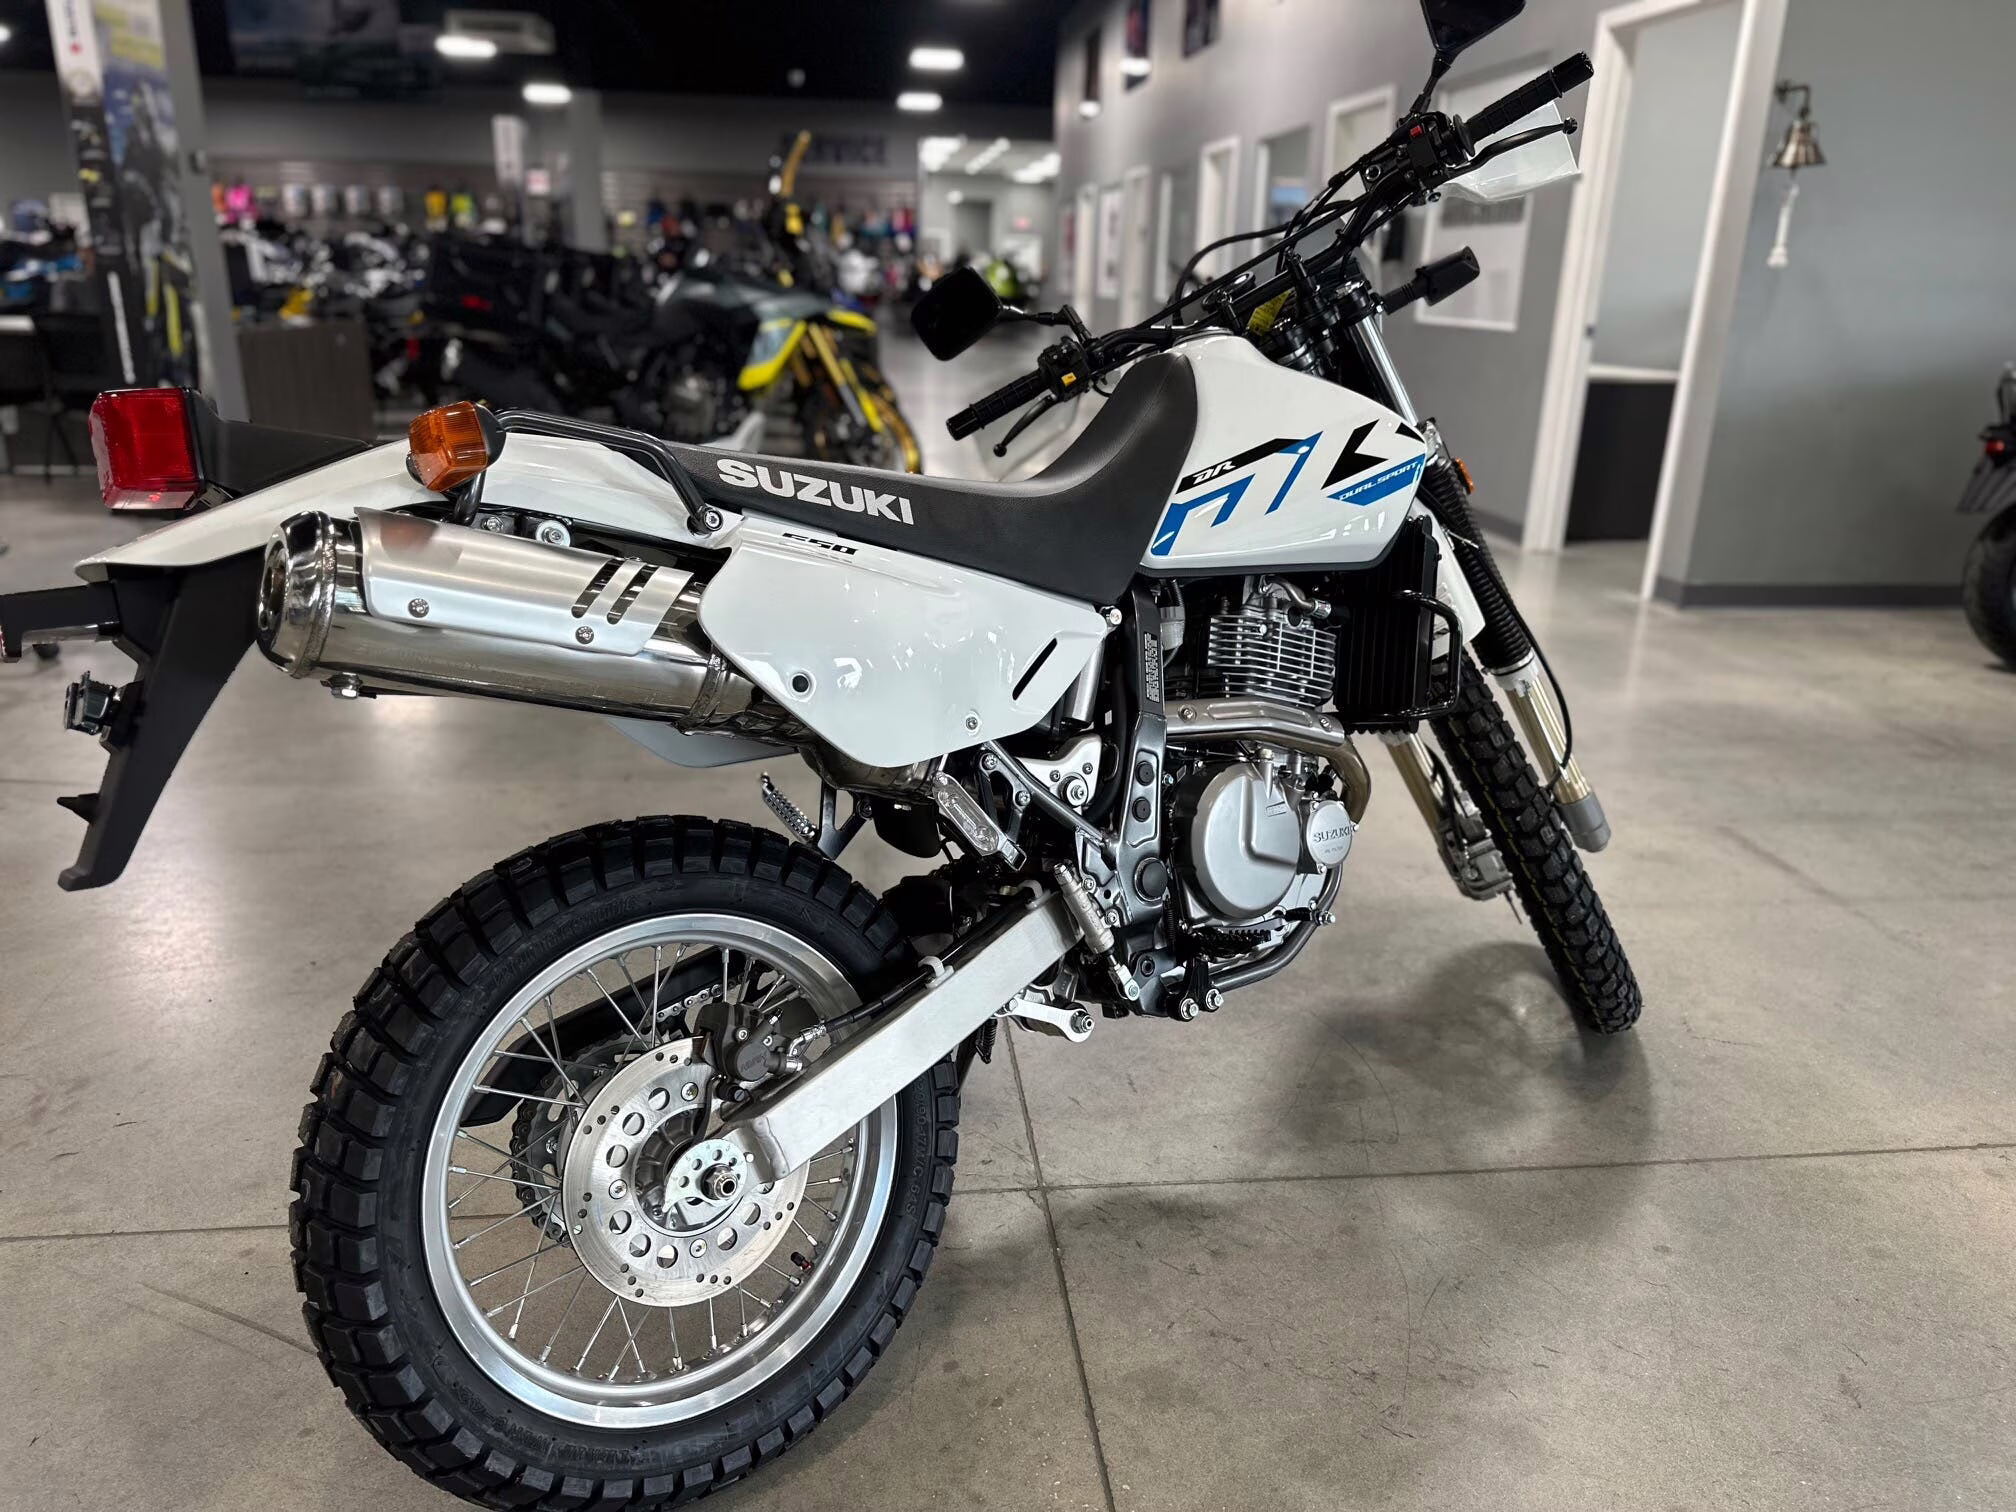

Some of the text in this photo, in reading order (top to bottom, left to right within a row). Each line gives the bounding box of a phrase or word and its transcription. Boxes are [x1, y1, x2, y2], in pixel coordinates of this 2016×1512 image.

[1193, 461, 1236, 485] DR
[1339, 461, 1418, 501] DUAL SPORT
[716, 458, 914, 525] SUZUKI
[1313, 824, 1353, 843] SUZUKI
